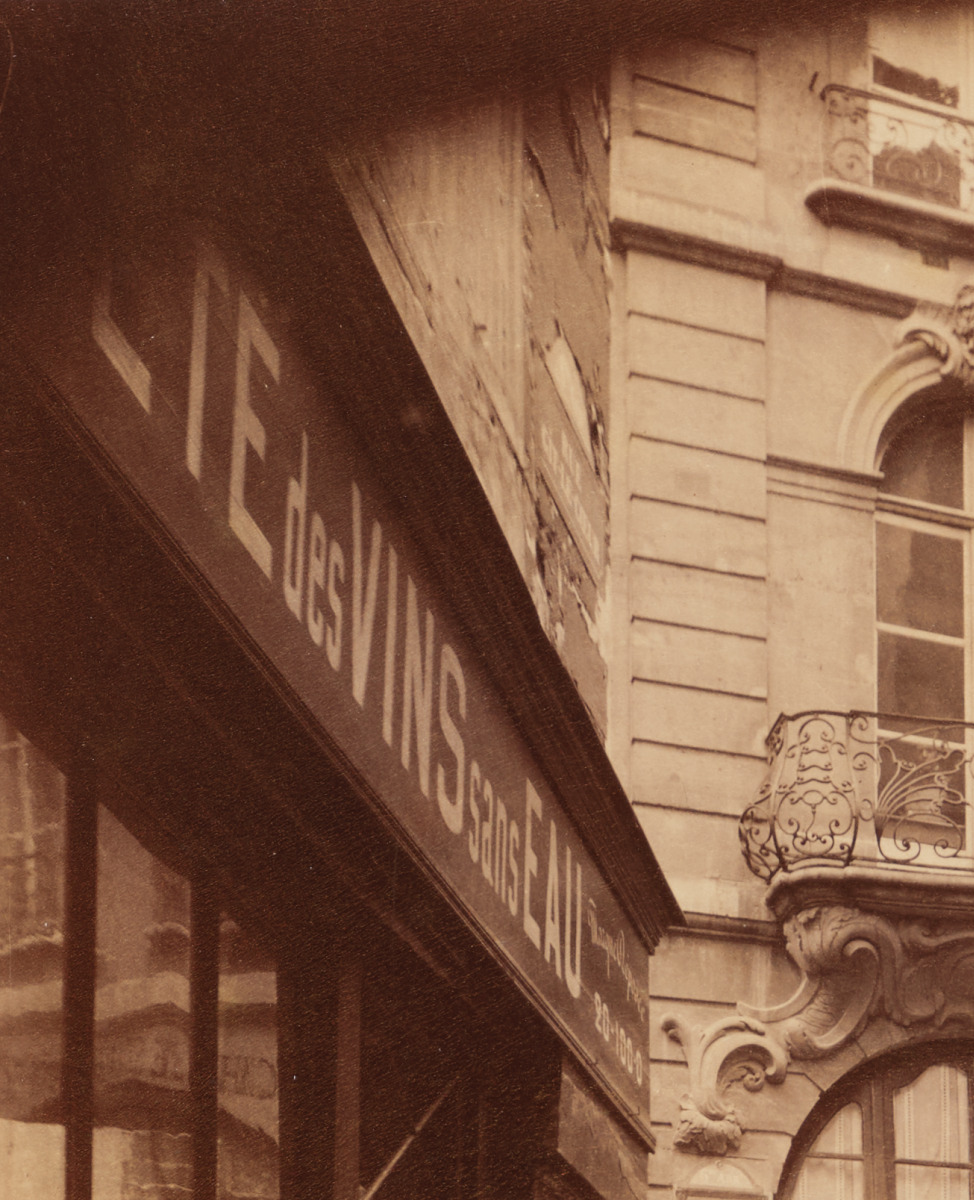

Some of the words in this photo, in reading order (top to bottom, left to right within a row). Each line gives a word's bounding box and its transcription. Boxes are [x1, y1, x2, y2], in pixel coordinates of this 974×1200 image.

[283, 430, 345, 672] des
[351, 481, 467, 834] VINS
[523, 777, 582, 998] EAU
